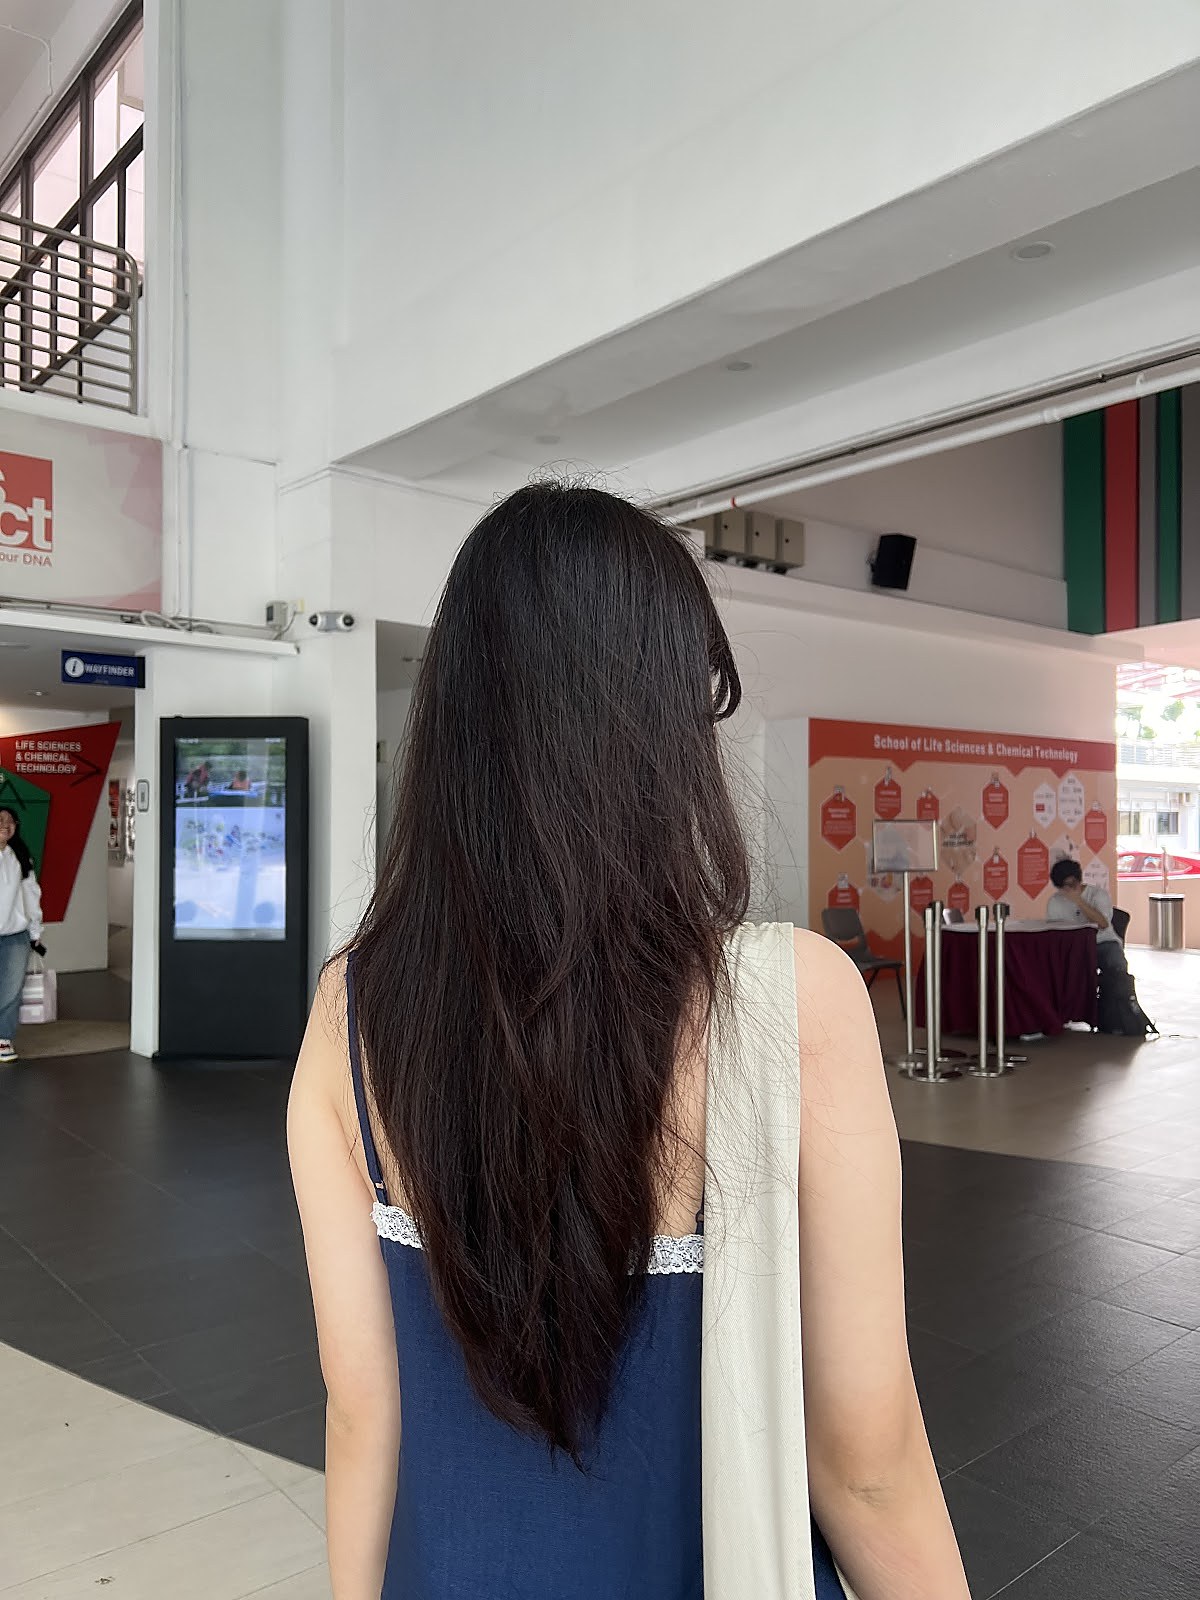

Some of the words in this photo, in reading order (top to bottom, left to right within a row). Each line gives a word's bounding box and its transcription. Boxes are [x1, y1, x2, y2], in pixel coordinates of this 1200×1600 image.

[22, 552, 52, 568] DNA
[84, 663, 135, 678] WAYFINDER
[15, 740, 35, 751] LIFE
[37, 740, 82, 752] SCIENCES
[873, 734, 908, 751] School
[911, 736, 922, 751] of
[924, 737, 942, 753] Life
[945, 738, 985, 756] Sciences
[988, 742, 994, 755] &
[996, 743, 1034, 759] Chemical
[1035, 745, 1079, 765] Technology
[15, 751, 23, 762] &
[24, 751, 70, 763] CHEMICAL
[16, 762, 77, 774] TECHNOLOGY
